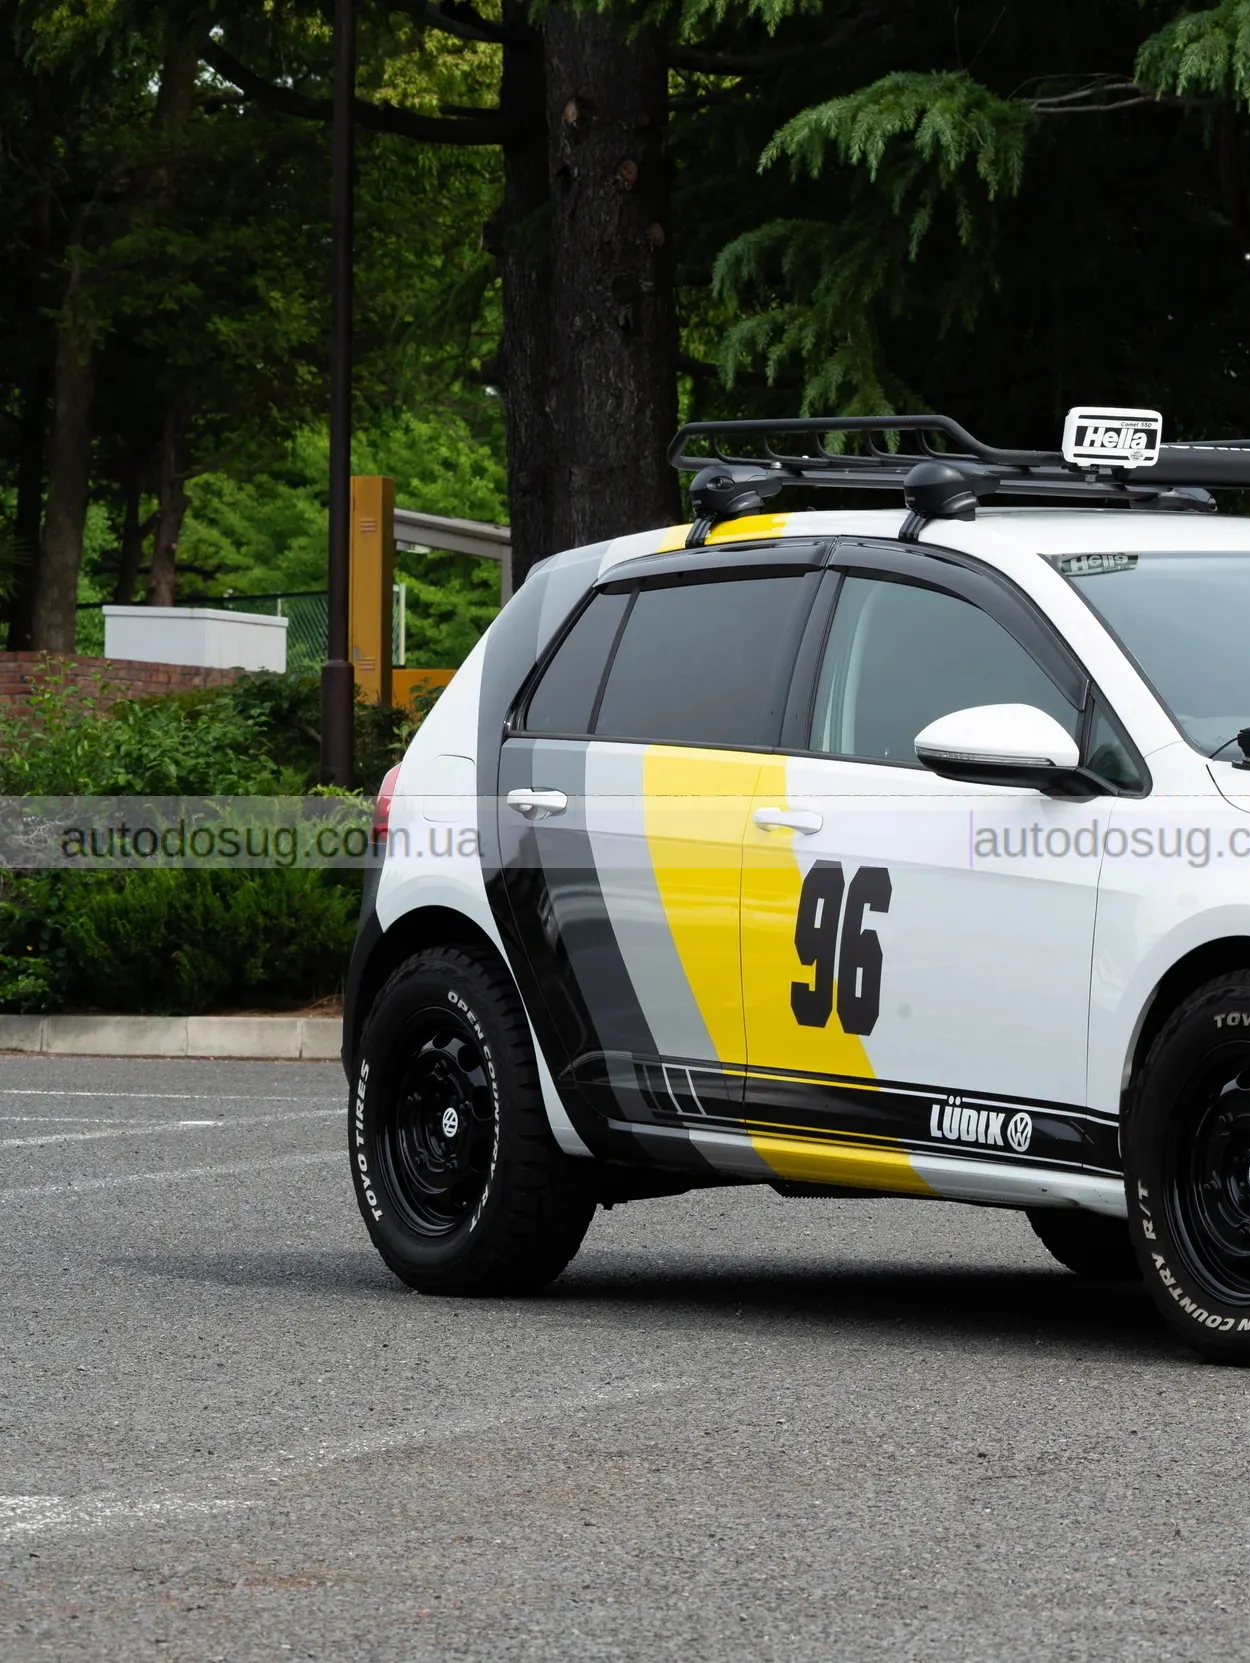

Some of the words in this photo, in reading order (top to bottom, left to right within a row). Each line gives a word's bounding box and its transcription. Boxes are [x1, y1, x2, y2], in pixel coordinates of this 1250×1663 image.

[1082, 426, 1148, 450] Hella
[790, 859, 893, 1037] 96
[447, 990, 485, 1041] OPEN
[355, 1058, 369, 1148] TIRES
[929, 1095, 1006, 1146] LÜDIX
[357, 1152, 385, 1223] TOYO
[1151, 1251, 1236, 1332] COUNTRY
